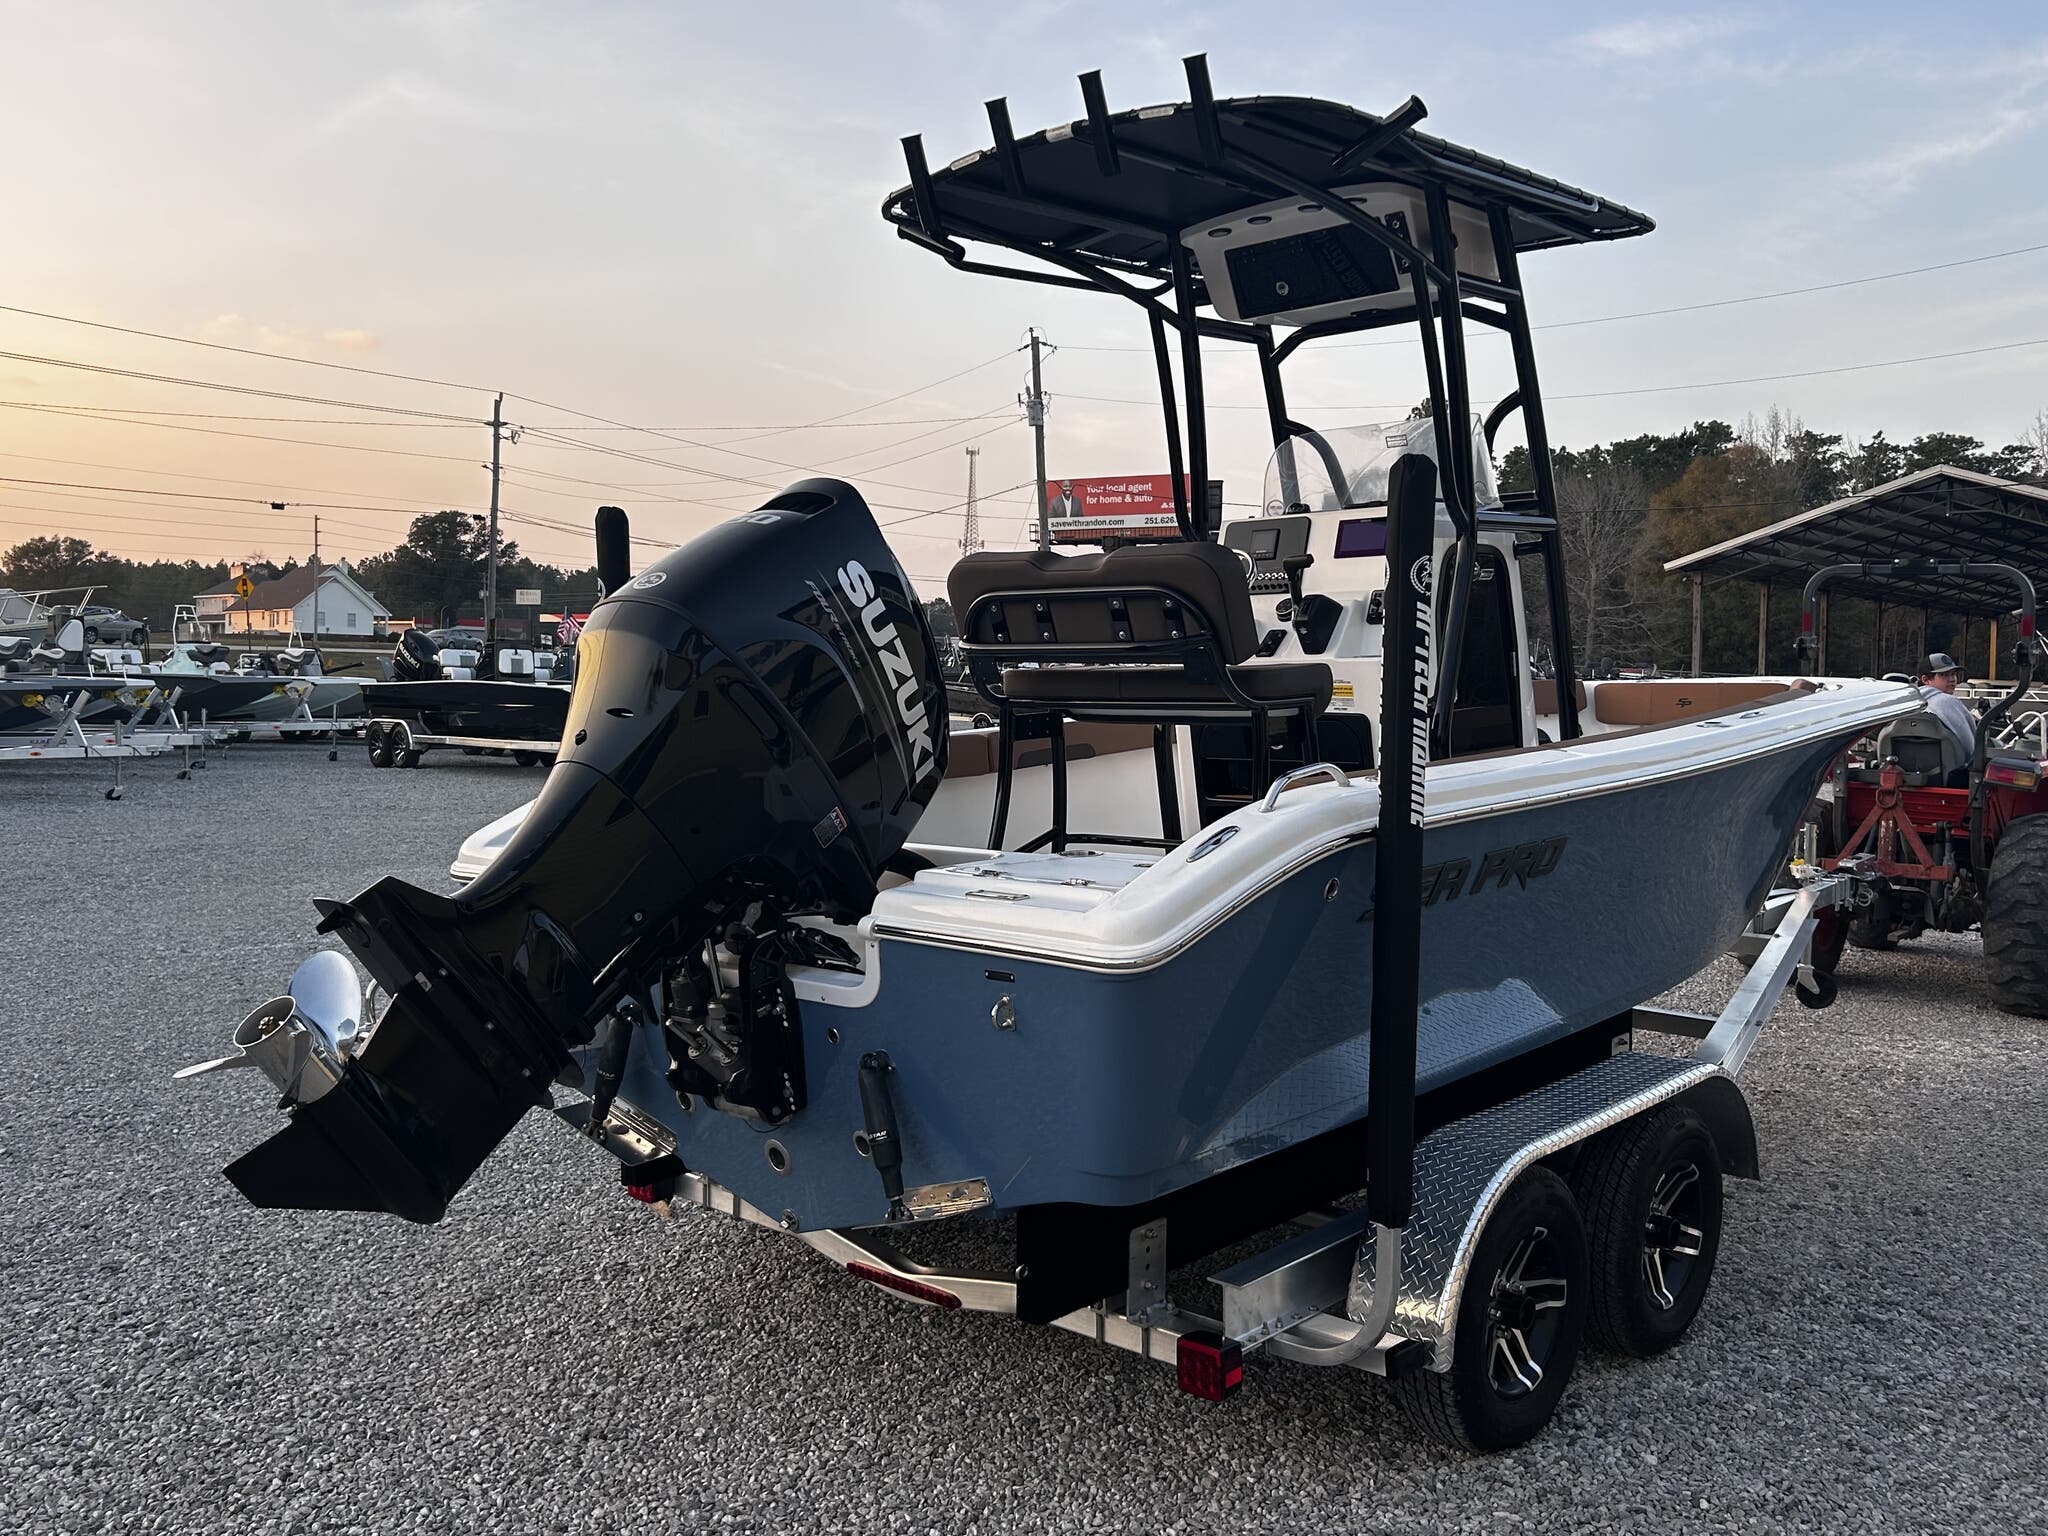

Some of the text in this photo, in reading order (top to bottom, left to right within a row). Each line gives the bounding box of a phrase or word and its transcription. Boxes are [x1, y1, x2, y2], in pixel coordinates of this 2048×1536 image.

[1087, 482, 1152, 493] Your local agent
[1086, 494, 1153, 504] for home & auto
[1051, 519, 1125, 528] savewithrandon.com
[836, 560, 935, 783] SUZUKI
[1469, 836, 1569, 895] PRO
